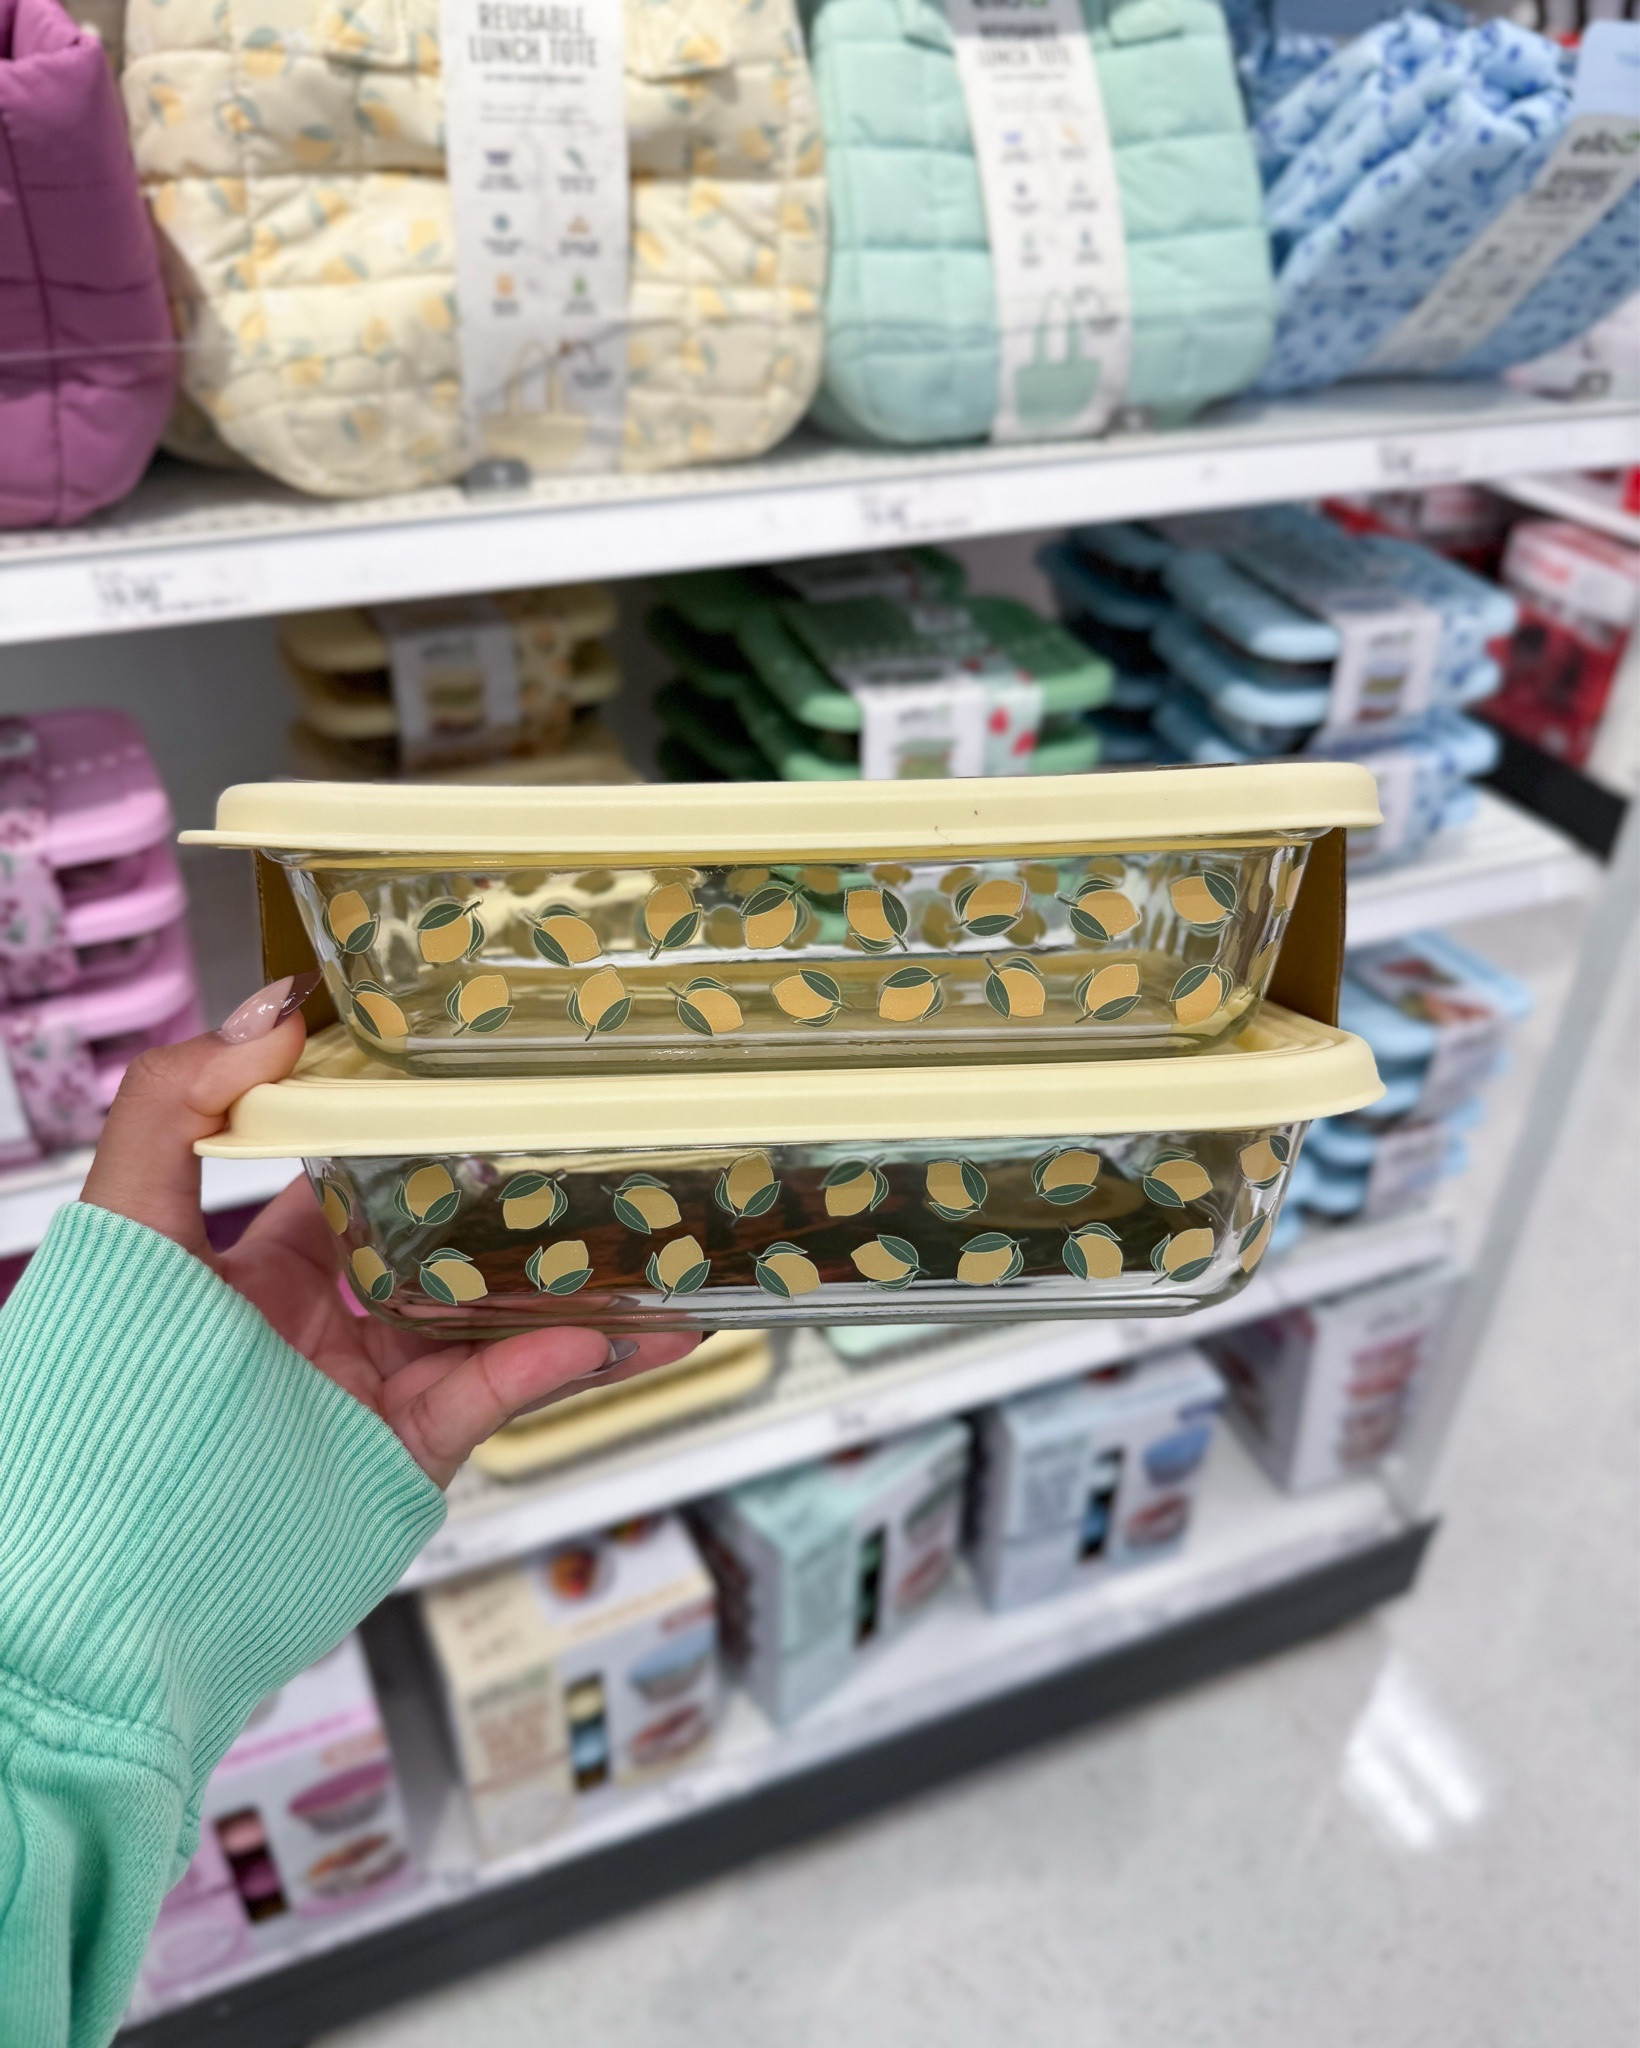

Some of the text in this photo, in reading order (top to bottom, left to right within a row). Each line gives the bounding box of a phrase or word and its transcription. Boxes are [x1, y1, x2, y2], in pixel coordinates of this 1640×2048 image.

[478, 1, 585, 32] REUSABLE
[468, 33, 598, 68] LUNCH TOTE
